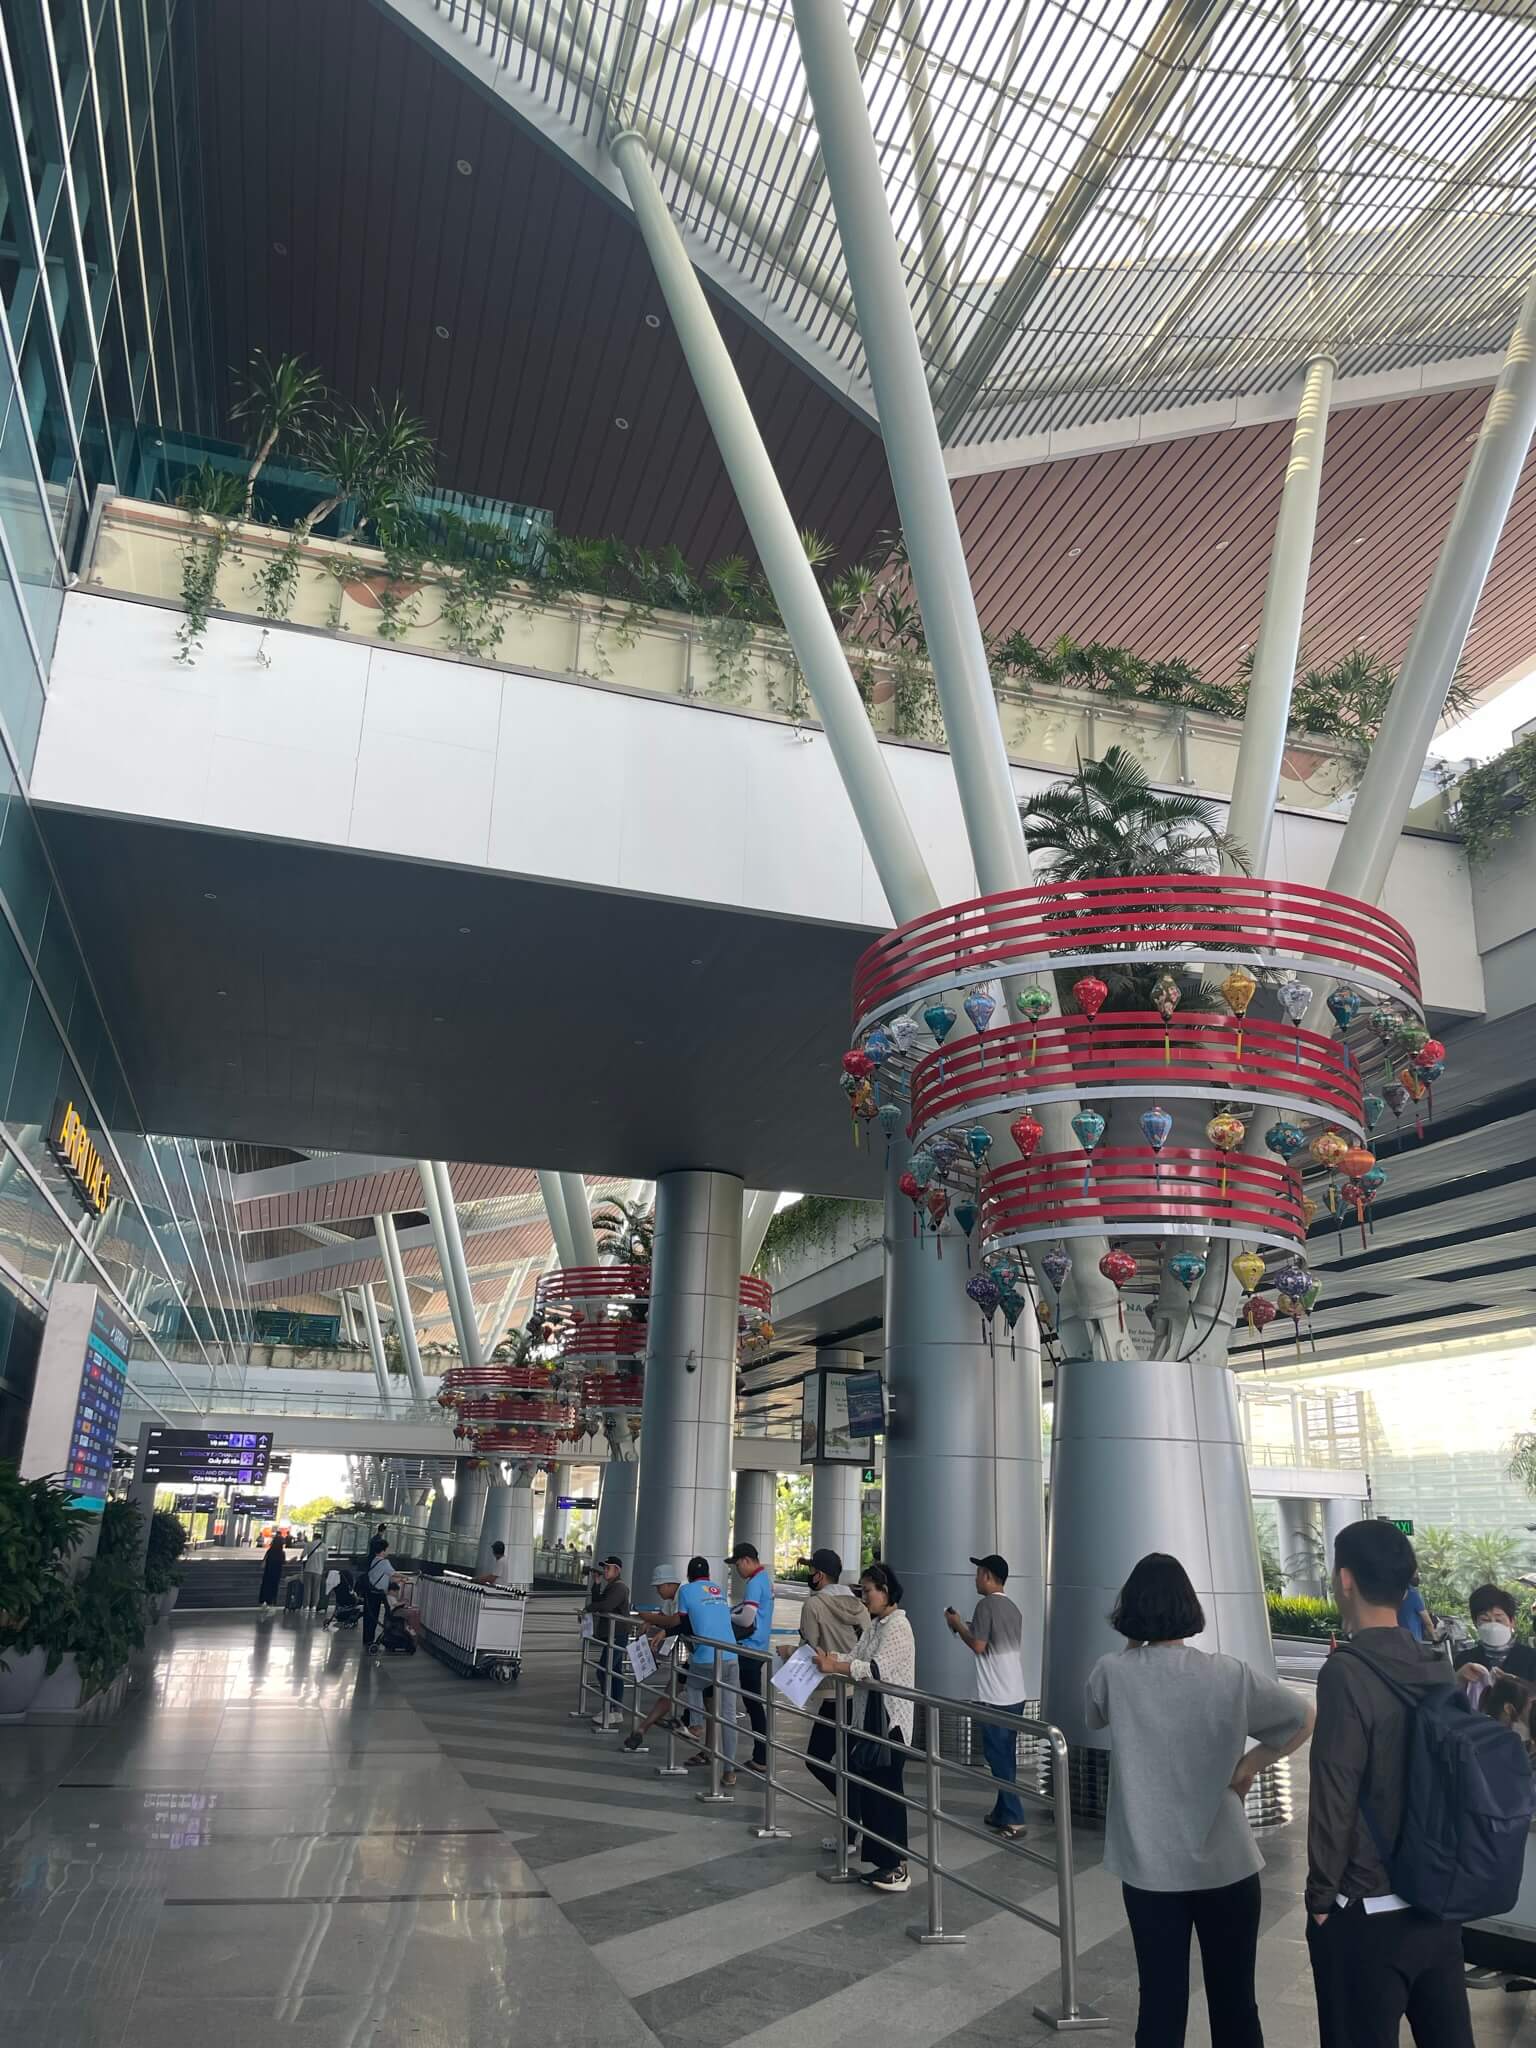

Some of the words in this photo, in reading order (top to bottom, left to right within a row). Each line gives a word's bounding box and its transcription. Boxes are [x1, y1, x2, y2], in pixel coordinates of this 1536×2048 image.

[60, 1101, 110, 1214] ARRIVALS
[864, 1470, 873, 1481] 4
[1392, 1521, 1410, 1534] AXI
